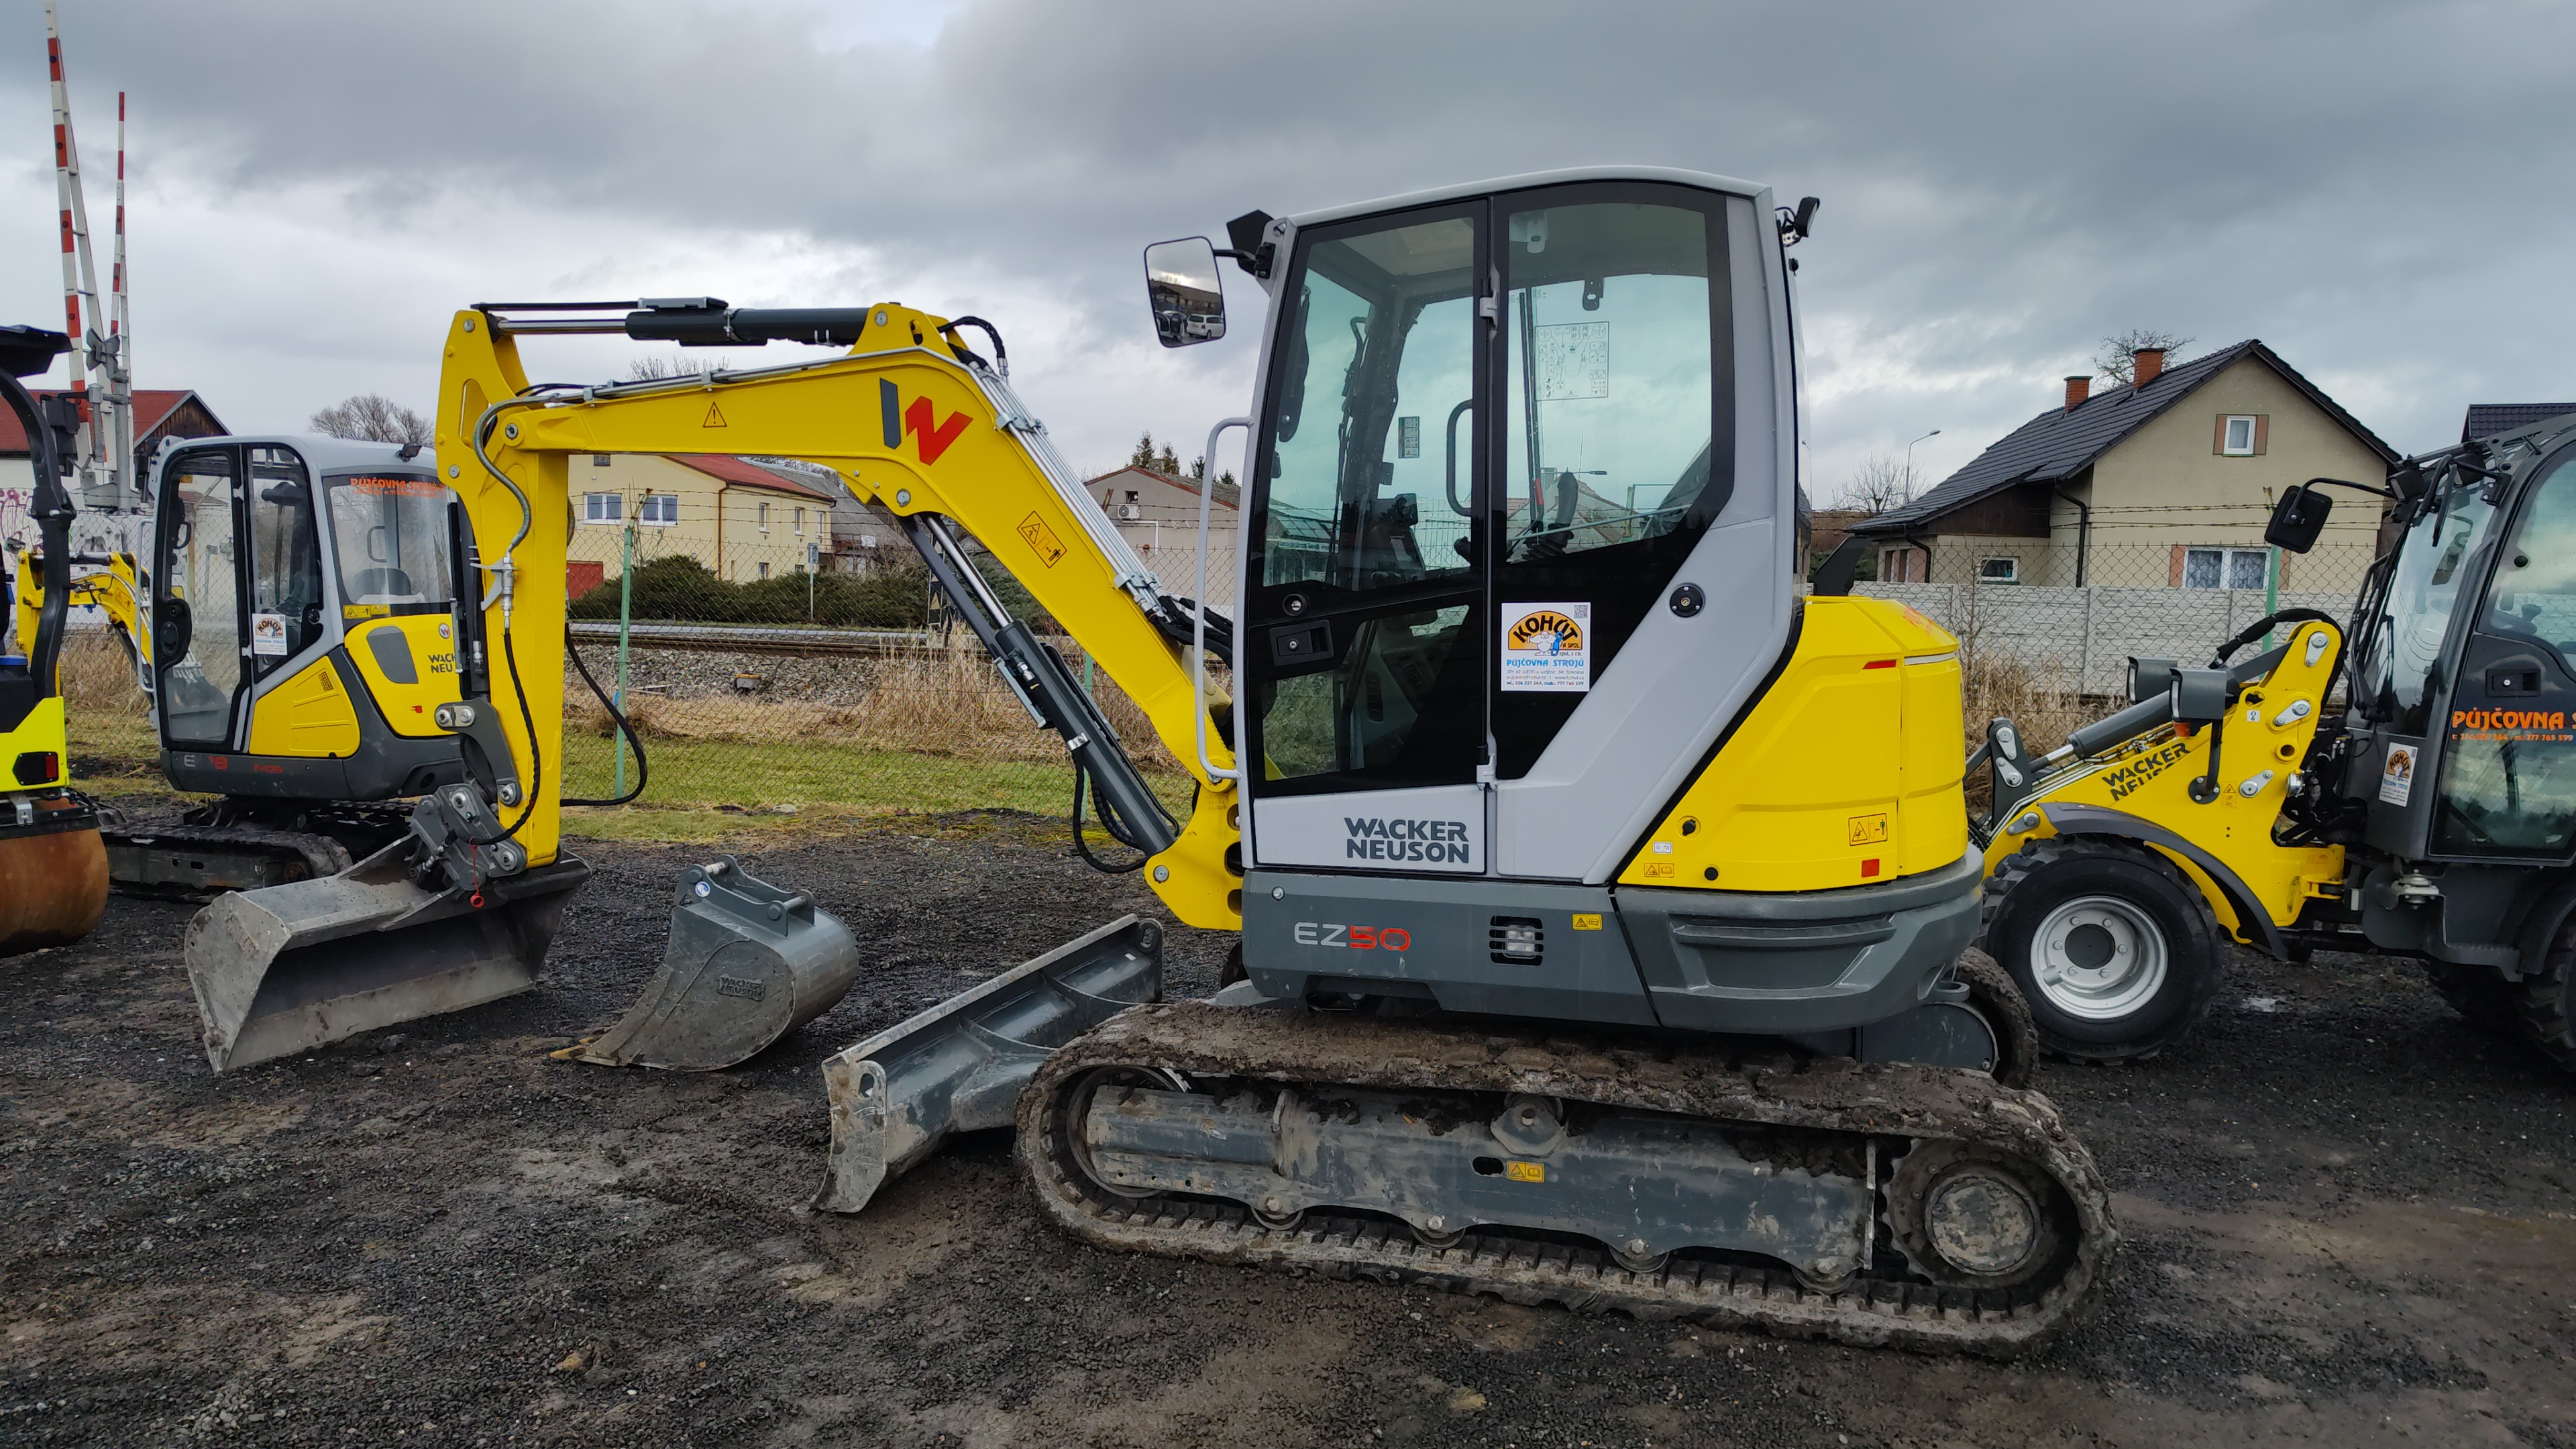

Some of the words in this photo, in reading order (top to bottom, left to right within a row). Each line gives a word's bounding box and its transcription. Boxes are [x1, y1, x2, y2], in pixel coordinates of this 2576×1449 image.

[1513, 614, 1578, 643] KOHÚT
[1507, 658, 1548, 667] PŮJČOVNA
[1553, 658, 1584, 667] STROJŮ
[2452, 706, 2565, 732] PŮJČOVNA
[2102, 743, 2191, 787] WACKER
[1343, 817, 1469, 843] WACKER
[1346, 839, 1469, 864] NEUSON
[1293, 921, 1411, 952] EZ50
